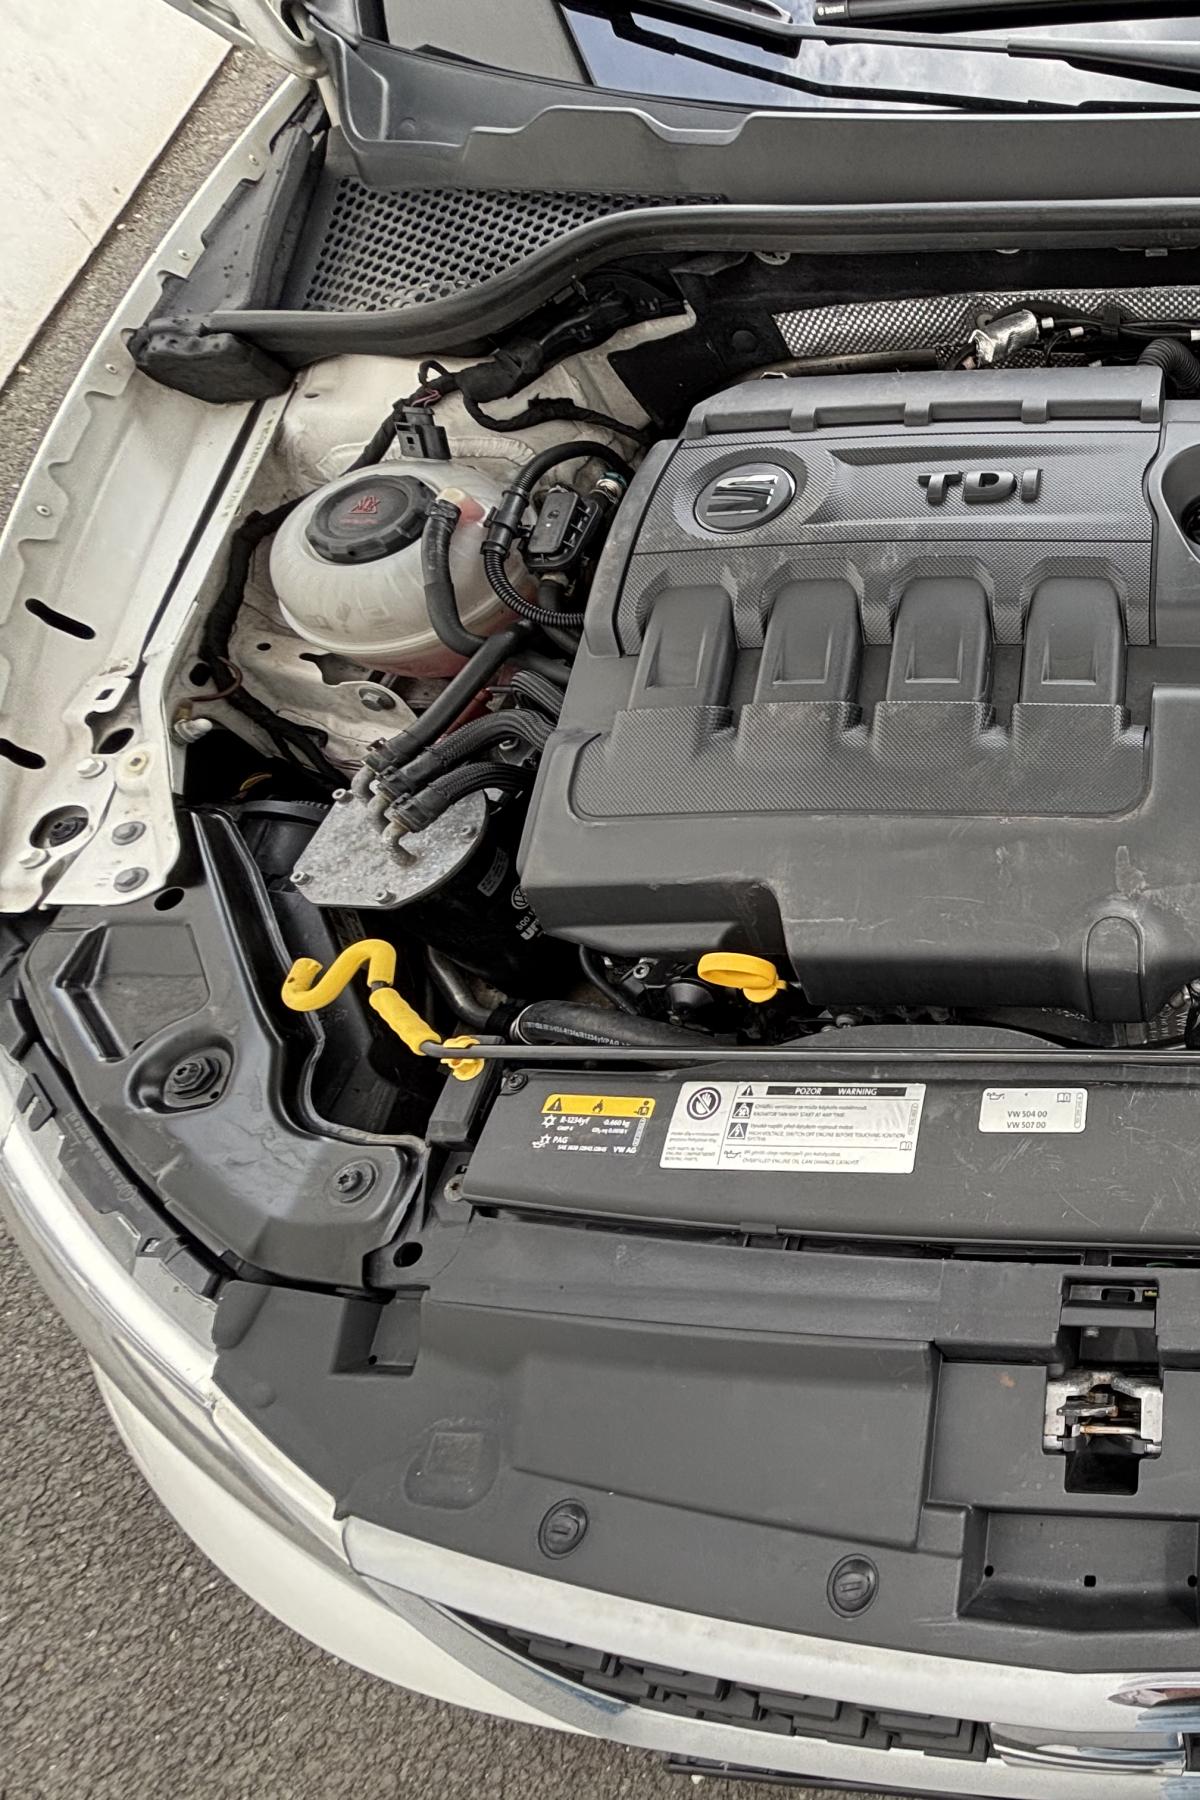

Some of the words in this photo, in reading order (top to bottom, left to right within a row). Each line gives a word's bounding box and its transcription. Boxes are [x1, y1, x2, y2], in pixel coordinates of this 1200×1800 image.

[918, 468, 1043, 506] TDI
[795, 1087, 822, 1095] POZOR
[838, 1087, 878, 1096] WARNING
[1008, 1110, 1021, 1118] VW
[1022, 1110, 1036, 1118] 504
[1037, 1110, 1048, 1118] 00
[1021, 1121, 1035, 1129] 507
[1036, 1121, 1047, 1129] 00
[552, 1136, 569, 1144] PAG
[625, 1146, 637, 1154] AG
